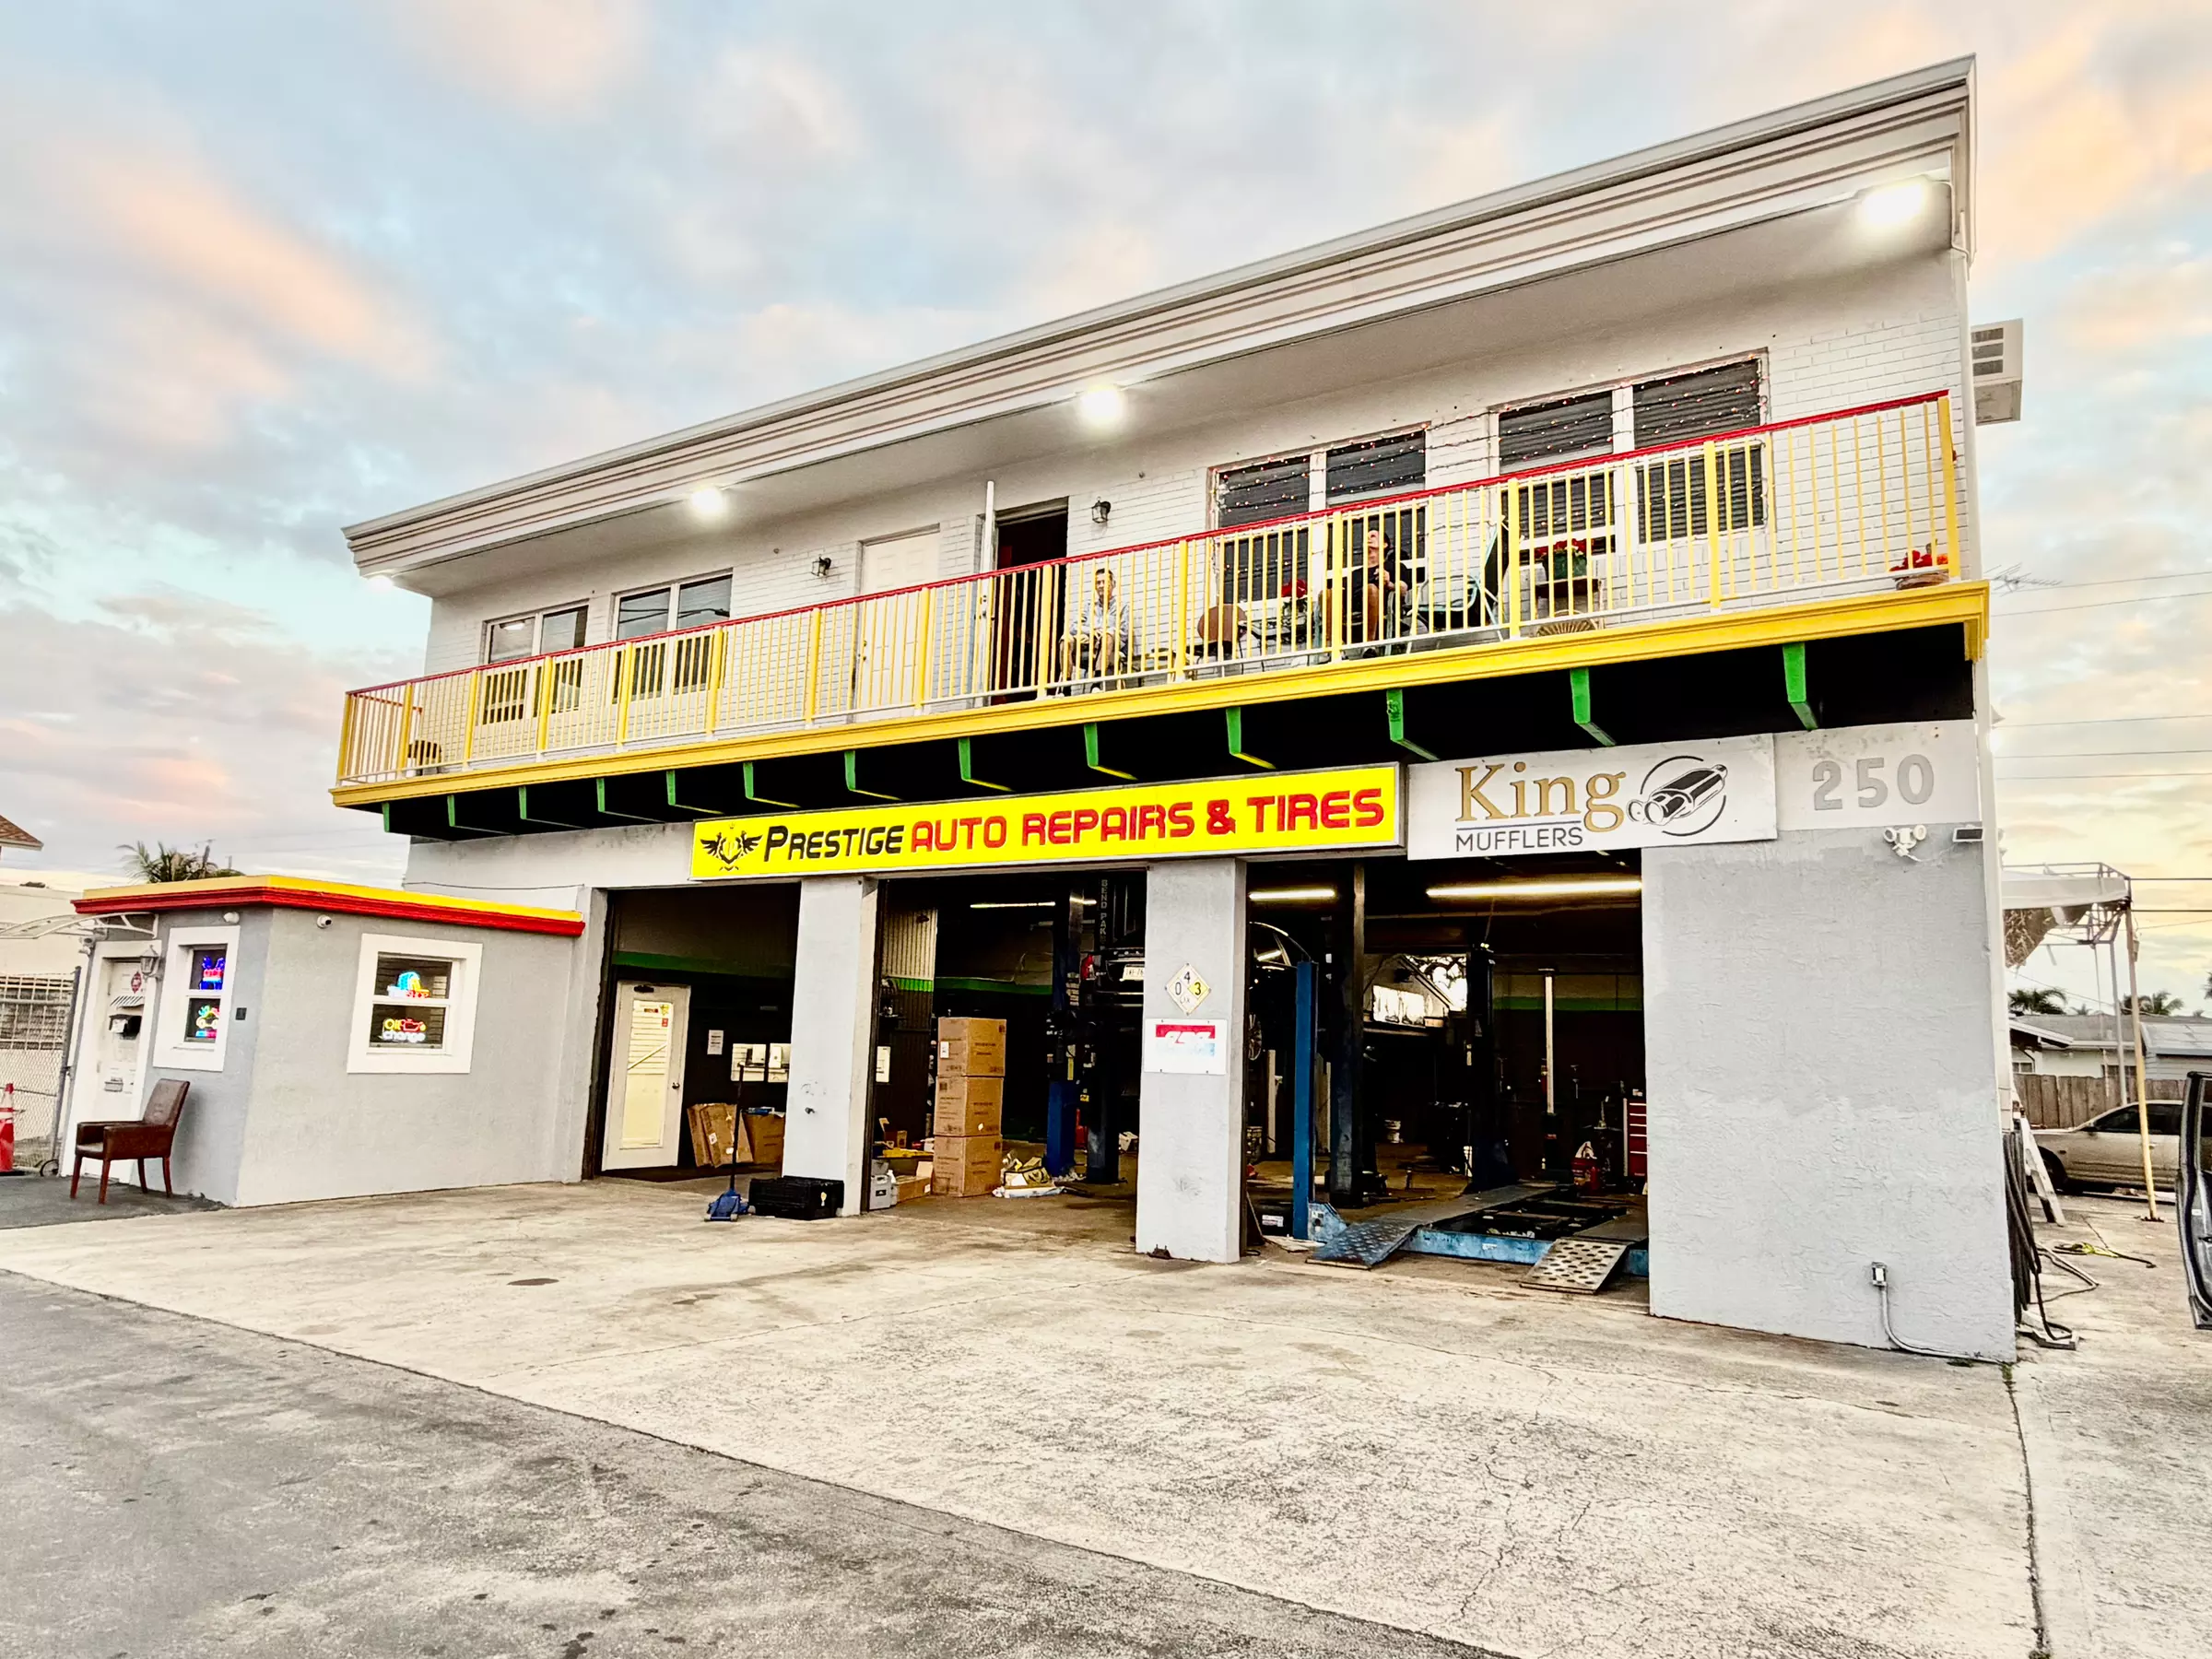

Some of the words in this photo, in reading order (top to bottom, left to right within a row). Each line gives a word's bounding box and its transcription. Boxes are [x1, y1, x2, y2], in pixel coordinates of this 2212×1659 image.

[1454, 760, 1628, 833] King
[1812, 753, 1935, 811] 250
[911, 815, 1007, 853] AUTO
[1021, 801, 1195, 847] REPAIRS
[1206, 799, 1236, 835] &
[1246, 788, 1384, 833] TIRES
[1455, 827, 1583, 853] MUFFLERS
[1183, 971, 1191, 983] 4
[1194, 982, 1202, 995] 3
